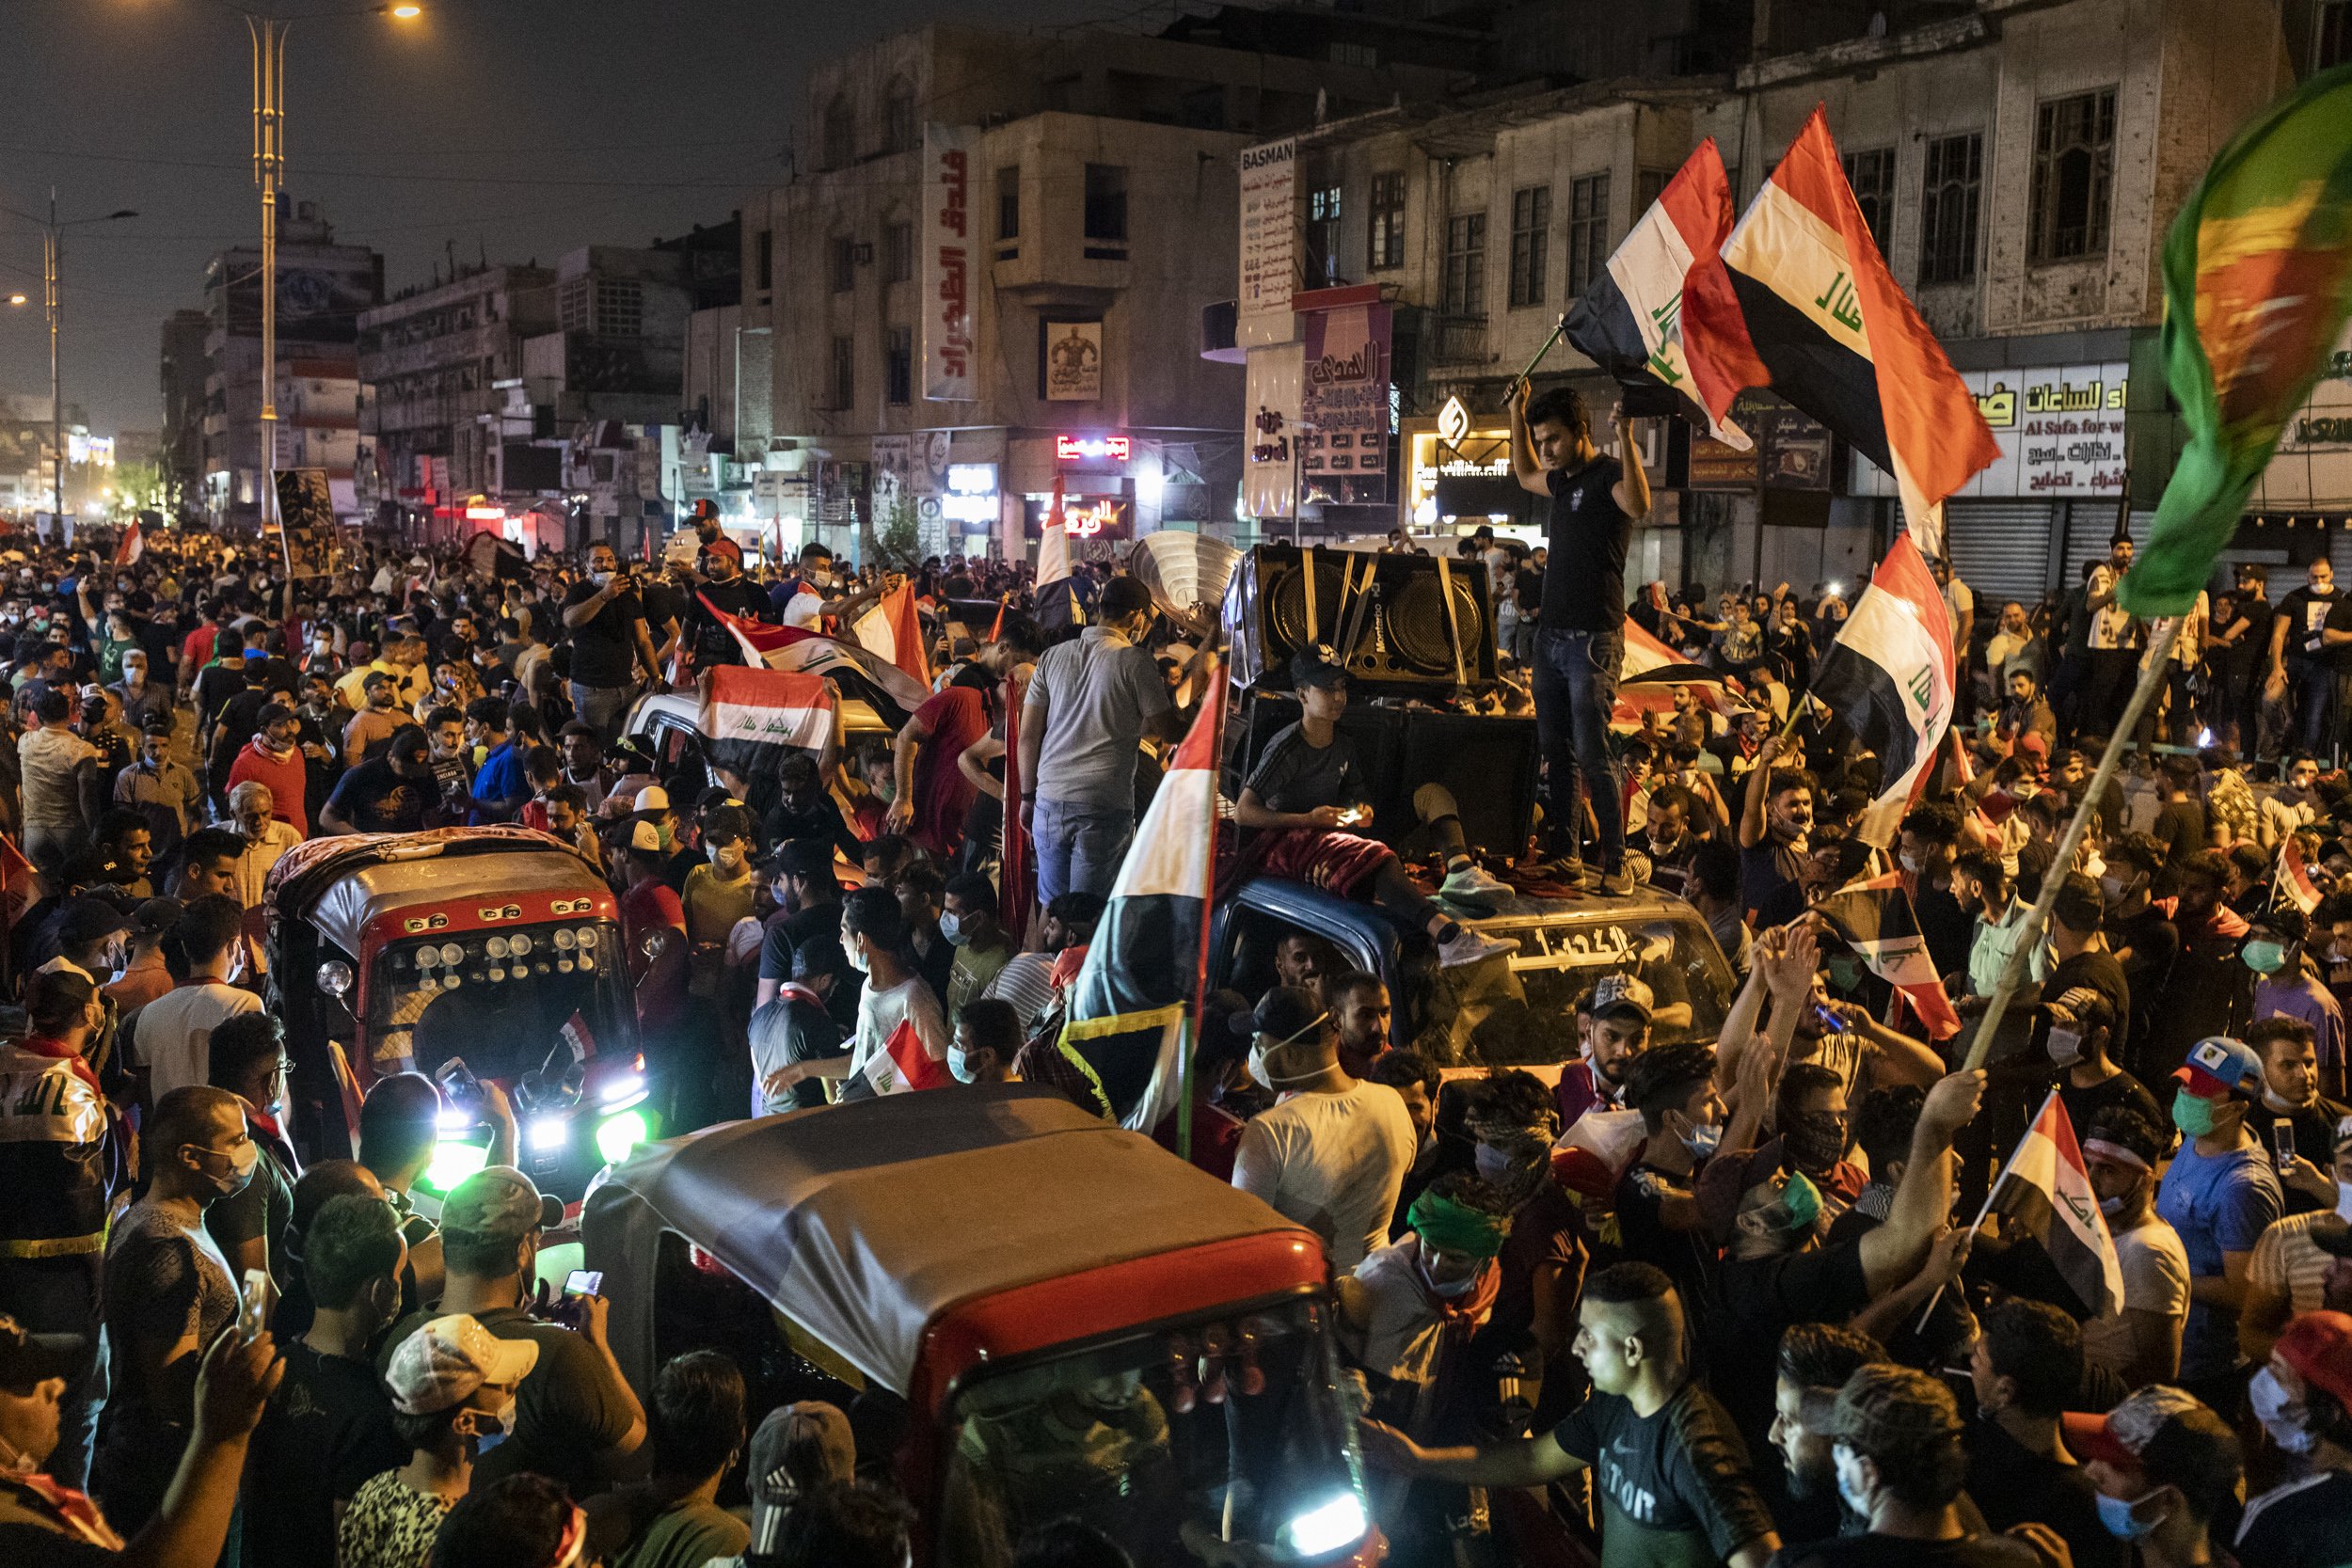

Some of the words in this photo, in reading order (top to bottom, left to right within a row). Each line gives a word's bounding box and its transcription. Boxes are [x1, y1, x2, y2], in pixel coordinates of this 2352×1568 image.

[1243, 143, 1293, 170] BASMAN
[939, 150, 967, 238] فندق
[1311, 340, 1378, 385] الهدى
[2026, 379, 2104, 413] للساعات
[2025, 420, 2042, 436] Al
[2044, 420, 2078, 436] Safa
[2081, 419, 2106, 435] for
[2068, 441, 2112, 464] نظارات
[2029, 470, 2074, 490] تصليح
[1375, 603, 1386, 654] Montarbo
